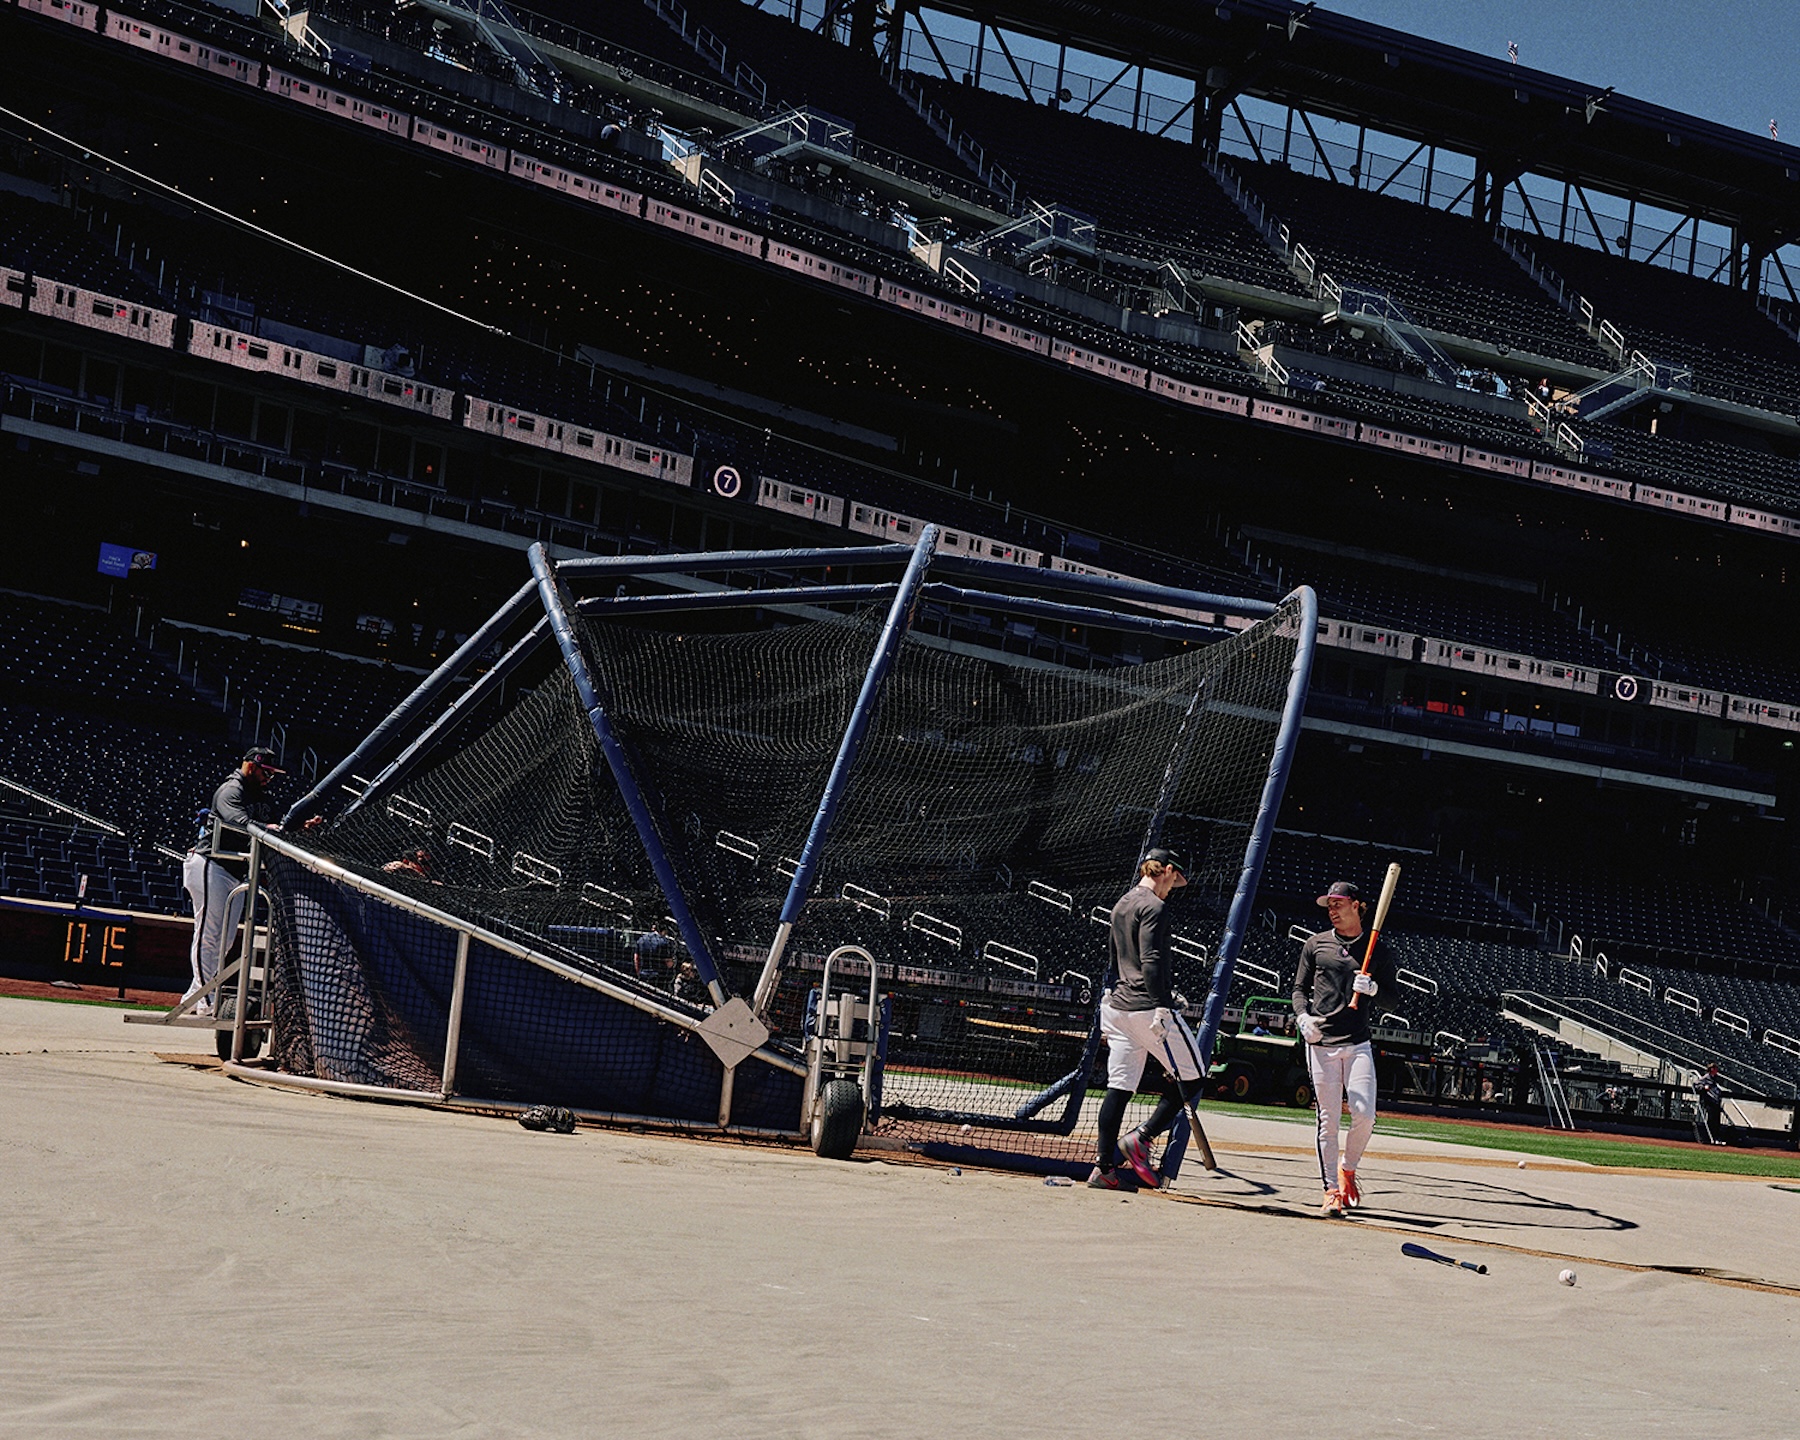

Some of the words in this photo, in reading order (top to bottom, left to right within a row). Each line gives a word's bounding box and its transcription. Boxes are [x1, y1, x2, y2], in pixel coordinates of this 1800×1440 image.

[619, 66, 633, 79] 522
[930, 185, 943, 197] 523
[723, 473, 733, 490] 7
[1623, 682, 1632, 695] 7
